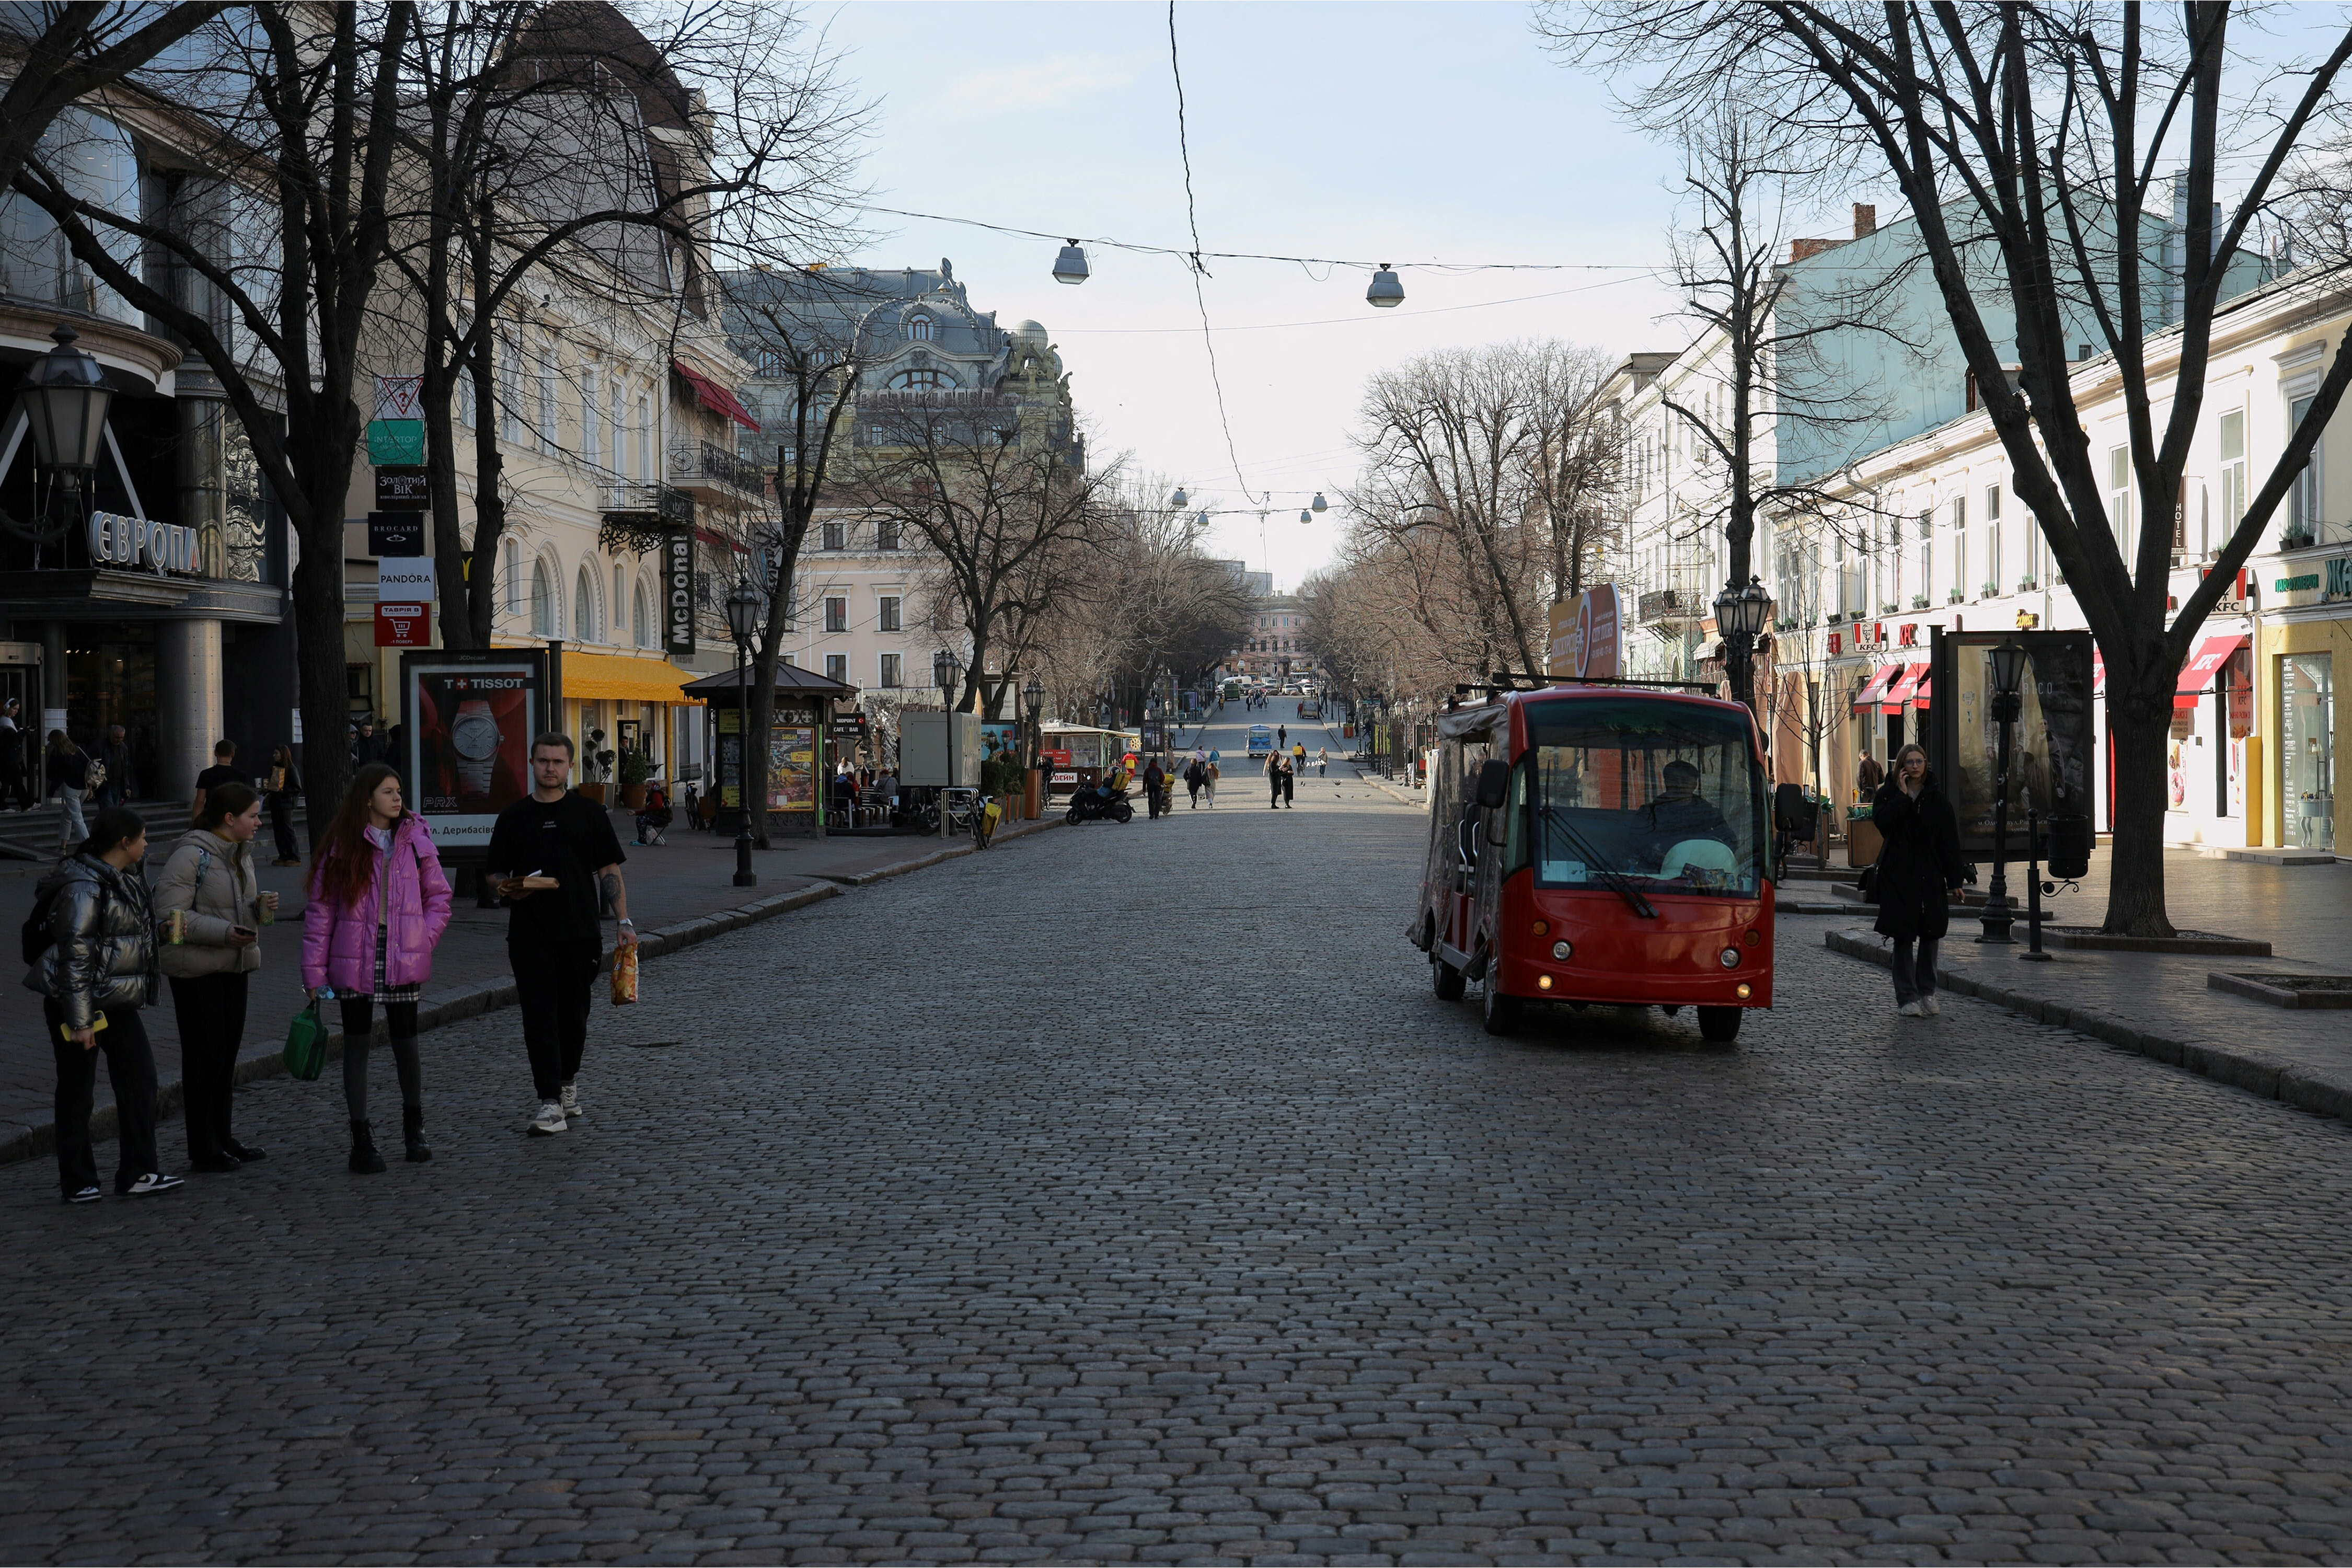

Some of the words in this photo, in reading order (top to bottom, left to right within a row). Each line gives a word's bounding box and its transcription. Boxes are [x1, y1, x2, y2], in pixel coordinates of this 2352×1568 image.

[381, 575, 431, 583] PANDORA
[1899, 624, 1913, 645] KFC
[470, 678, 524, 689] TISSOT
[423, 797, 457, 808] PRX
